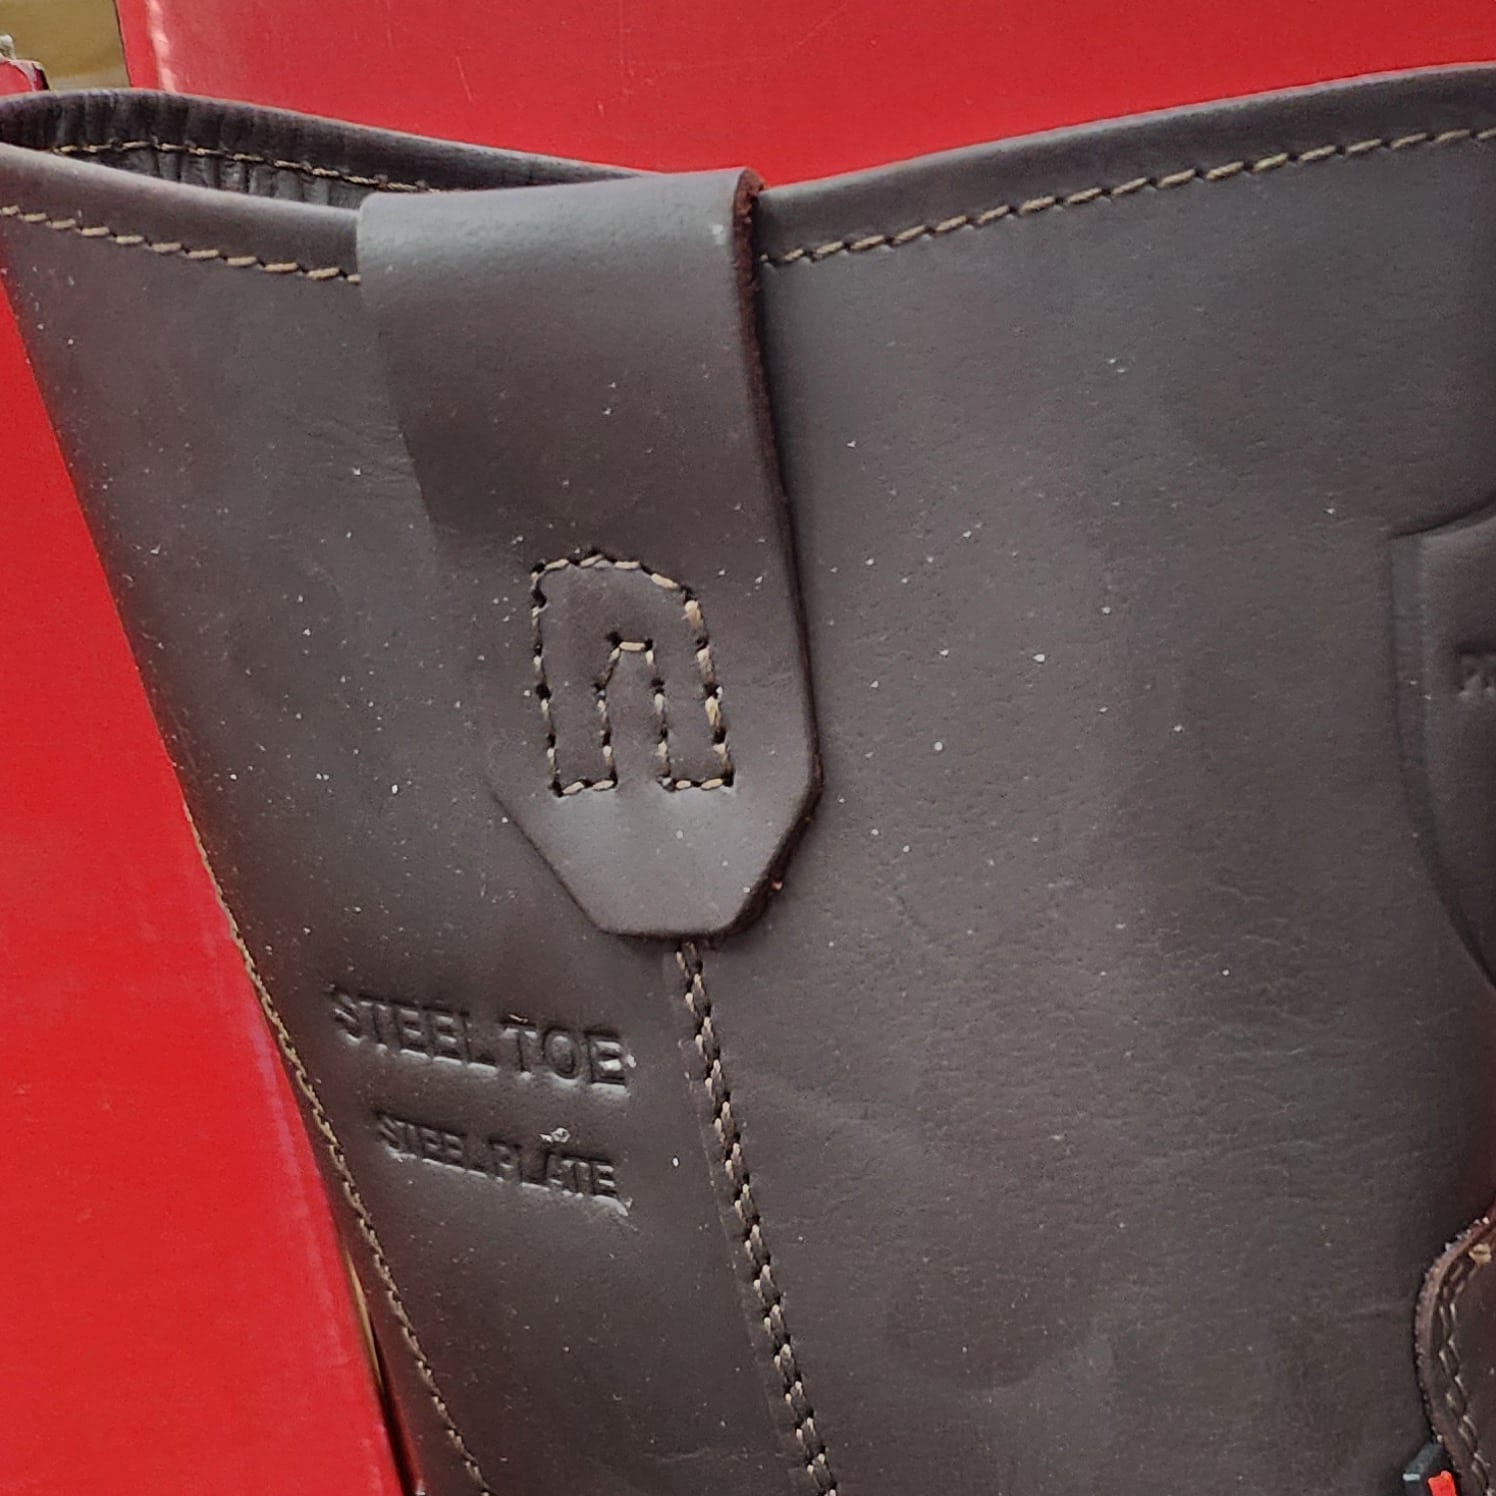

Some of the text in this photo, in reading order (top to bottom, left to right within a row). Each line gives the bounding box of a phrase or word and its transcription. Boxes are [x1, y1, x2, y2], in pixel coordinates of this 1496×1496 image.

[325, 986, 629, 1094] STEEL TOE
[488, 1137, 619, 1204] PLATE
